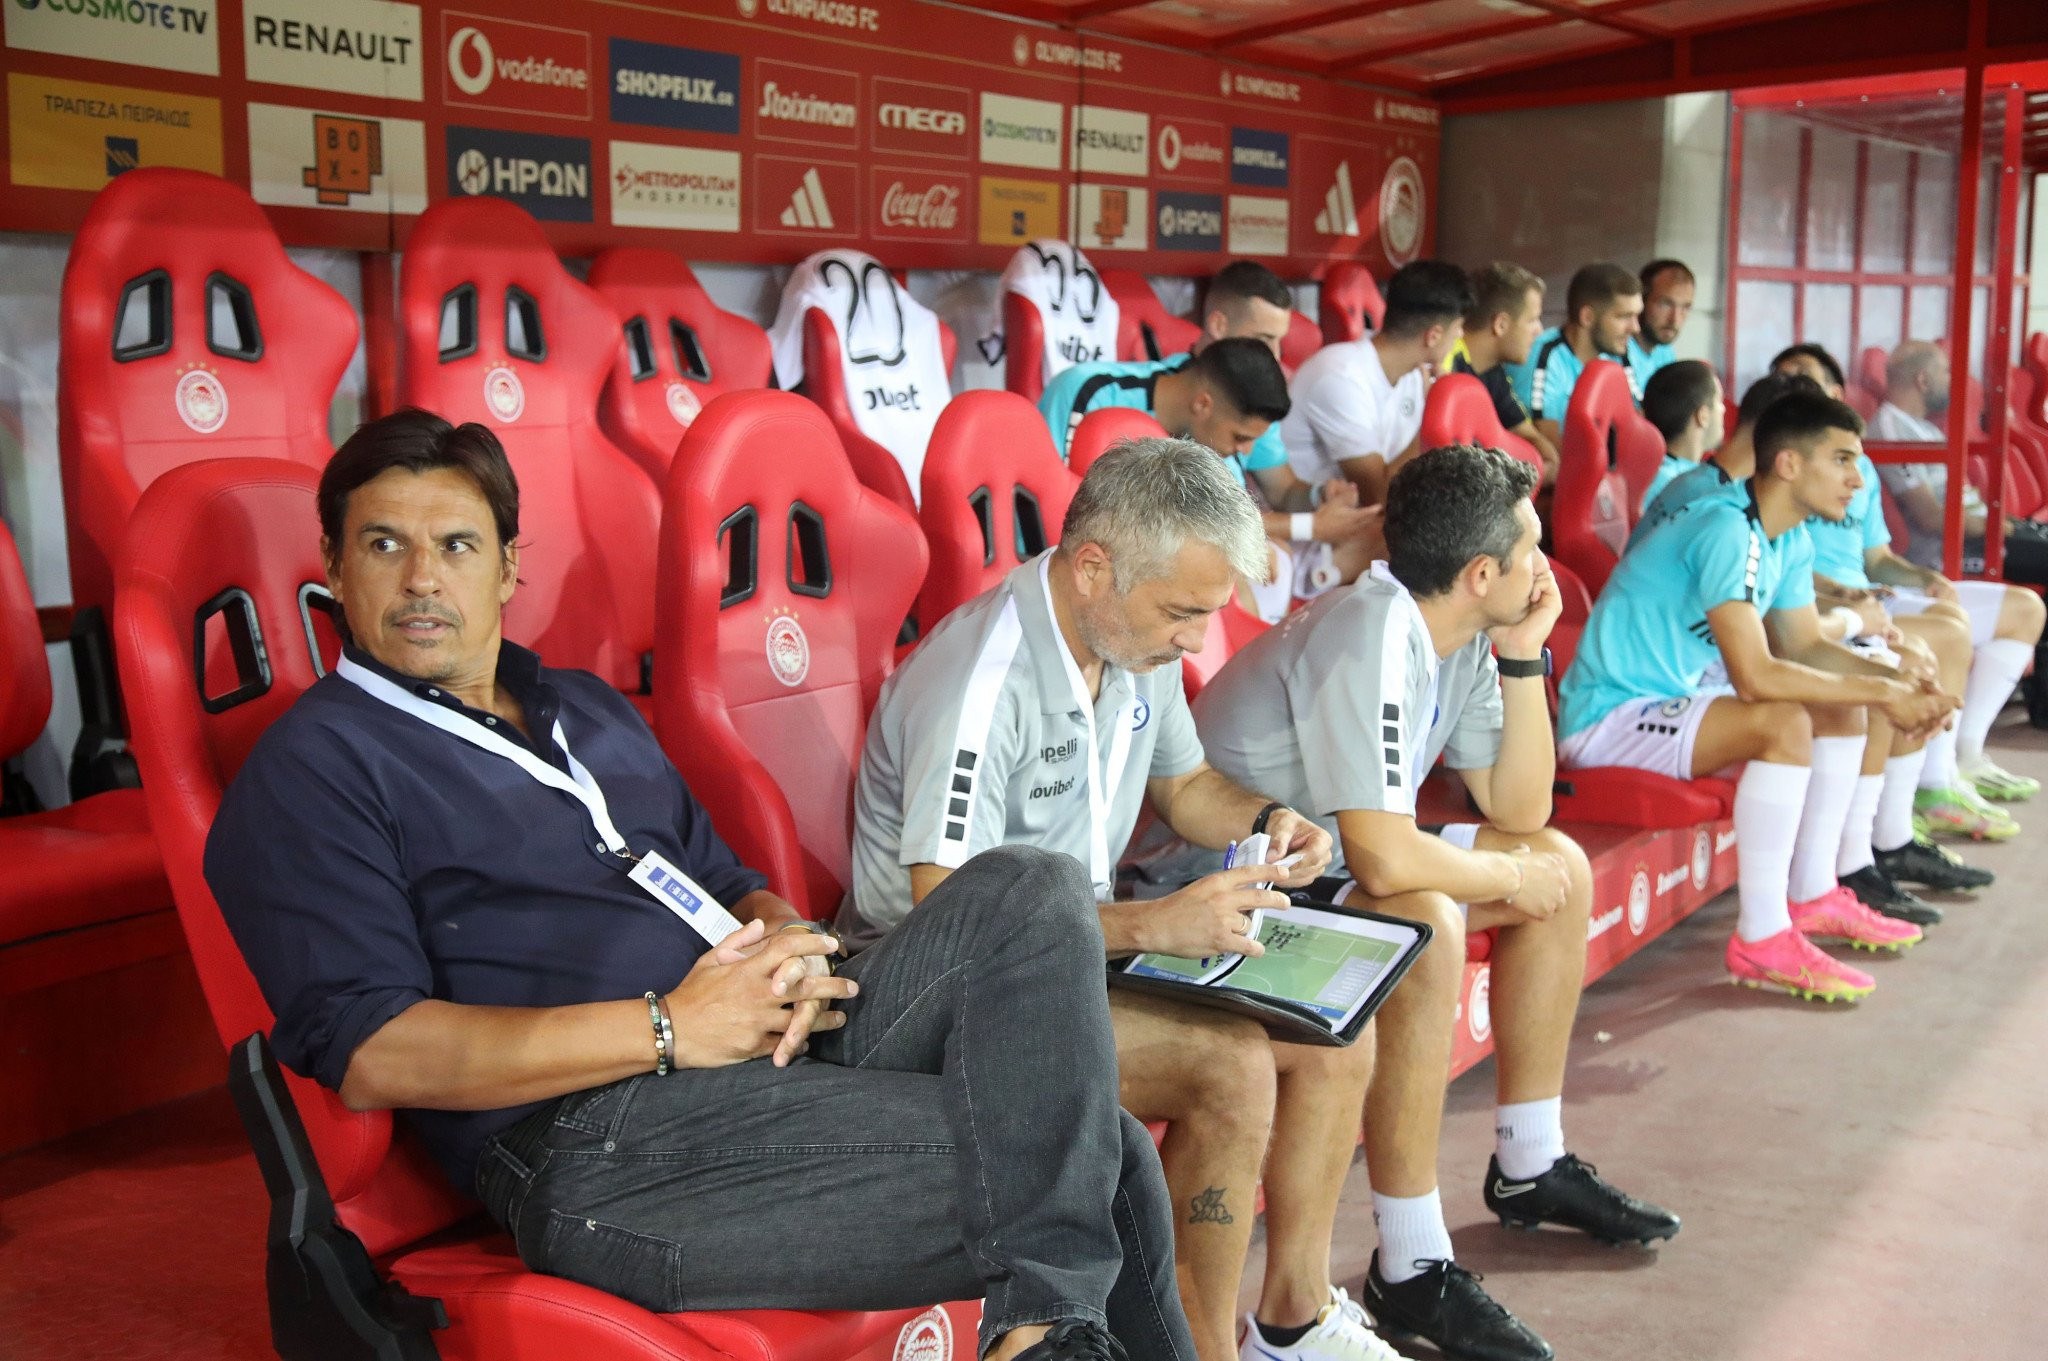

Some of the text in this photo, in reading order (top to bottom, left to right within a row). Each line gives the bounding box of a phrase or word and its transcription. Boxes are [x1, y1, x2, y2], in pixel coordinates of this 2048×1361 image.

[859, 7, 880, 32] FC
[254, 15, 412, 65] RENAULT
[496, 55, 588, 90] vodafone
[758, 81, 857, 128] Stoiximan
[634, 170, 736, 192] METROPOLITAN
[634, 190, 736, 207] HOSPITAL
[1040, 738, 1077, 763] pelli
